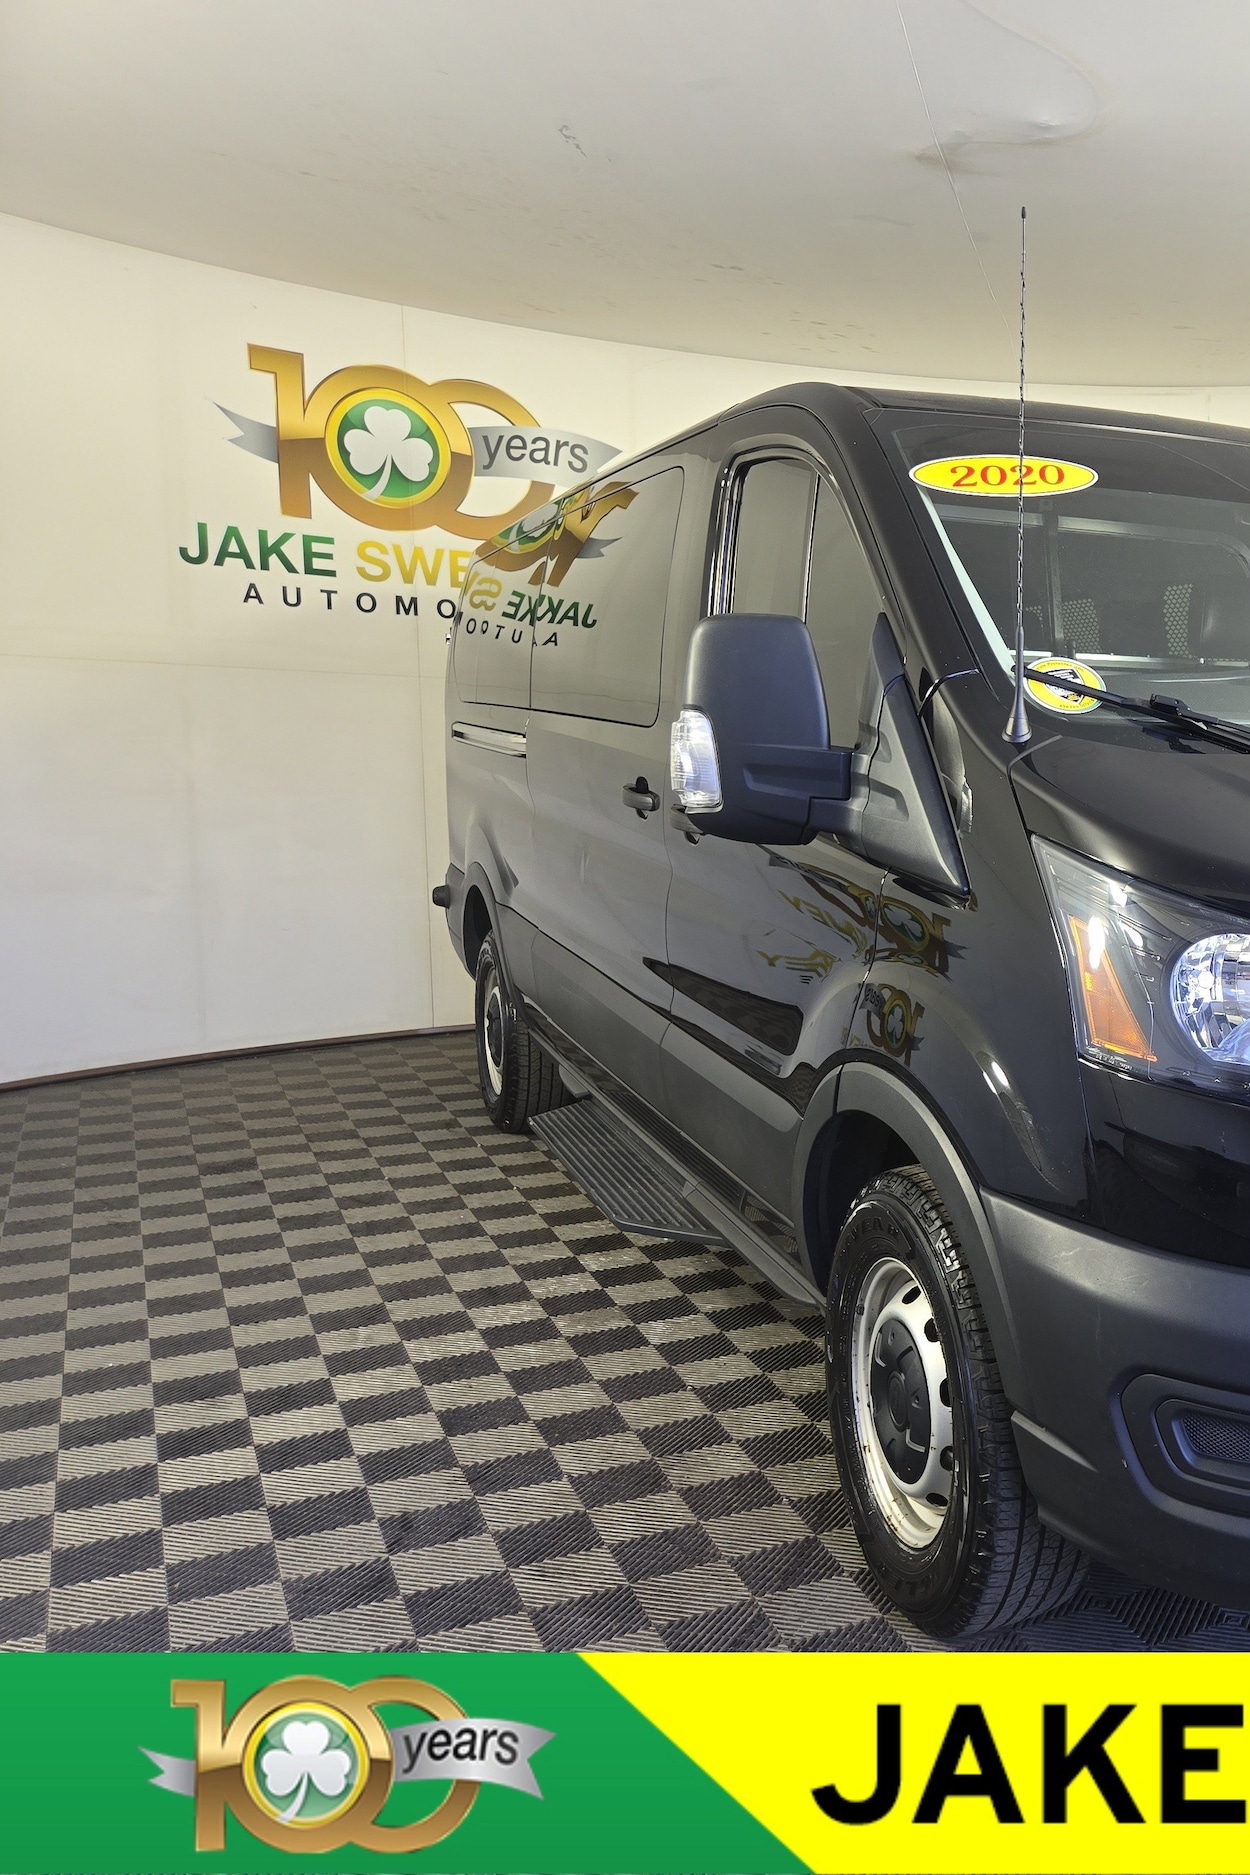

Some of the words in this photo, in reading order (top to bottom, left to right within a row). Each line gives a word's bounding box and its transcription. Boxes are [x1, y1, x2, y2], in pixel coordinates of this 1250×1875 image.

[481, 428, 590, 474] years
[949, 463, 1066, 488] 2020
[179, 522, 337, 577] JAKE
[243, 582, 459, 619] AUTOMO
